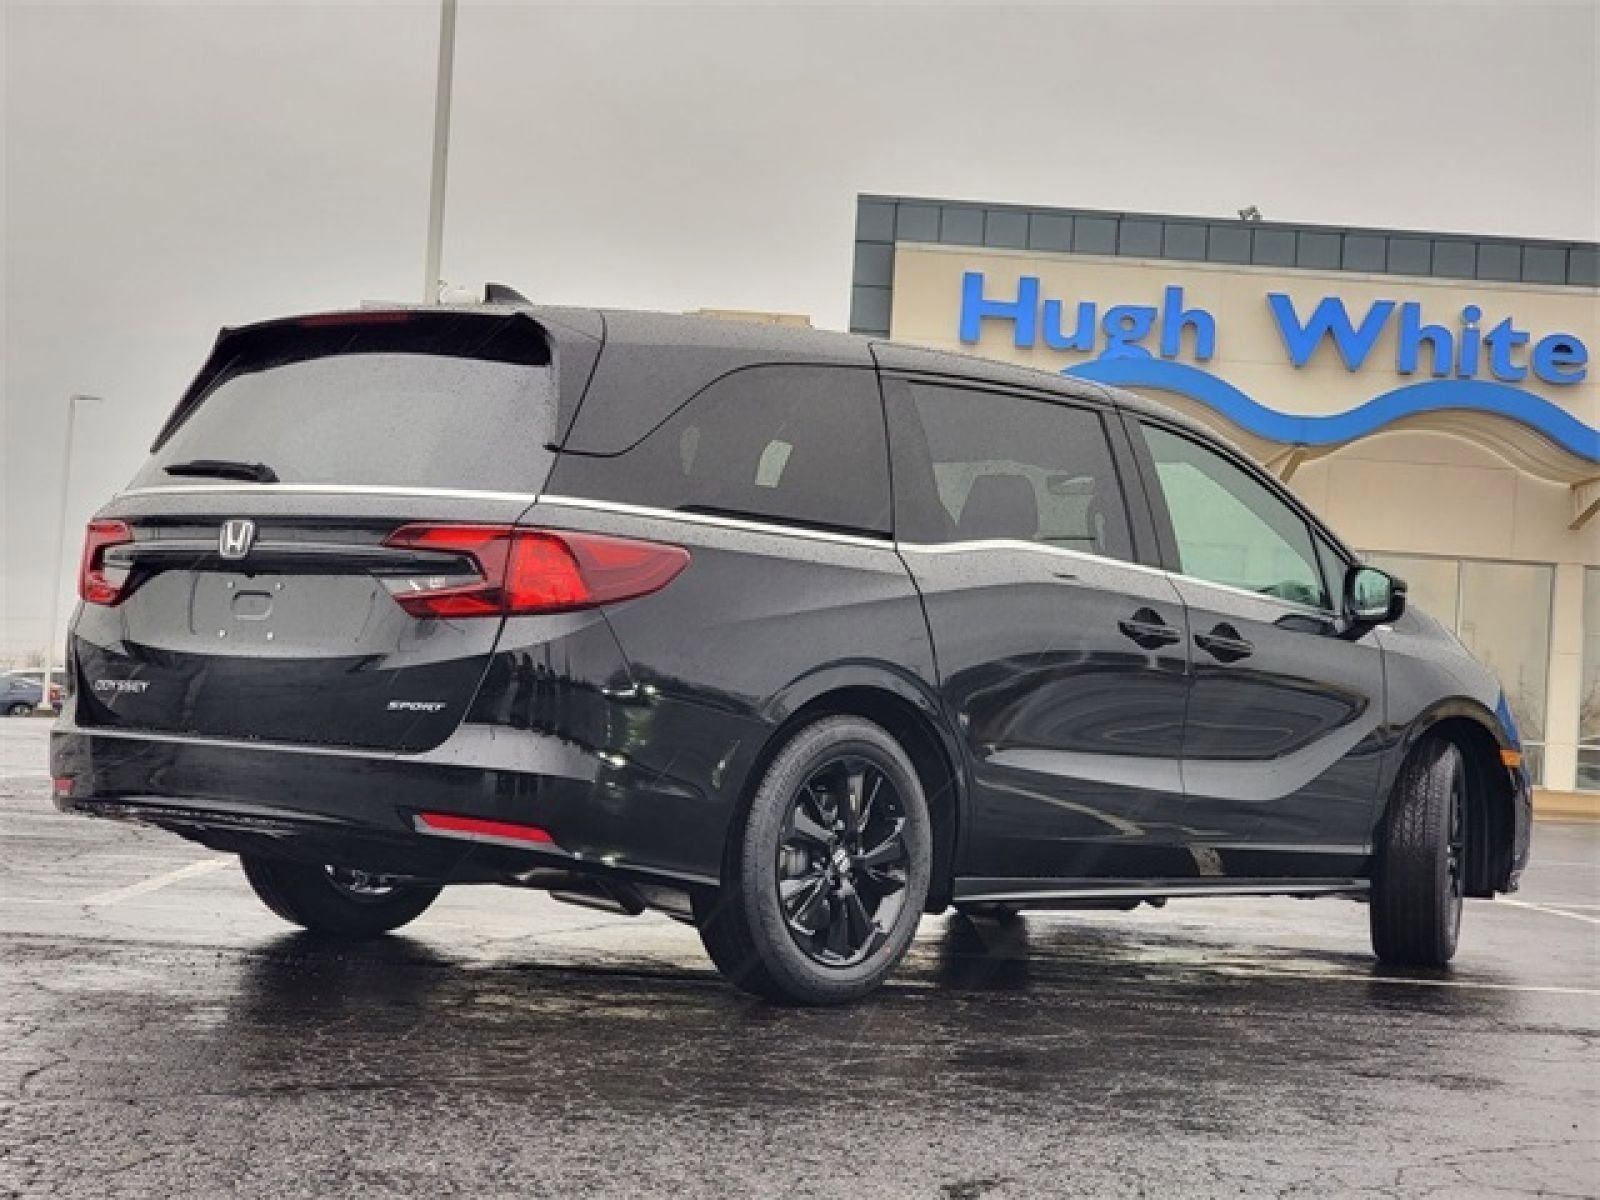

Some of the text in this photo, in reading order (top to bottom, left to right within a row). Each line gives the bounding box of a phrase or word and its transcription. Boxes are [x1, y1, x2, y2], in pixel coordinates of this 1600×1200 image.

[959, 271, 1589, 385] Hugh White
[386, 700, 447, 711] SPORT
